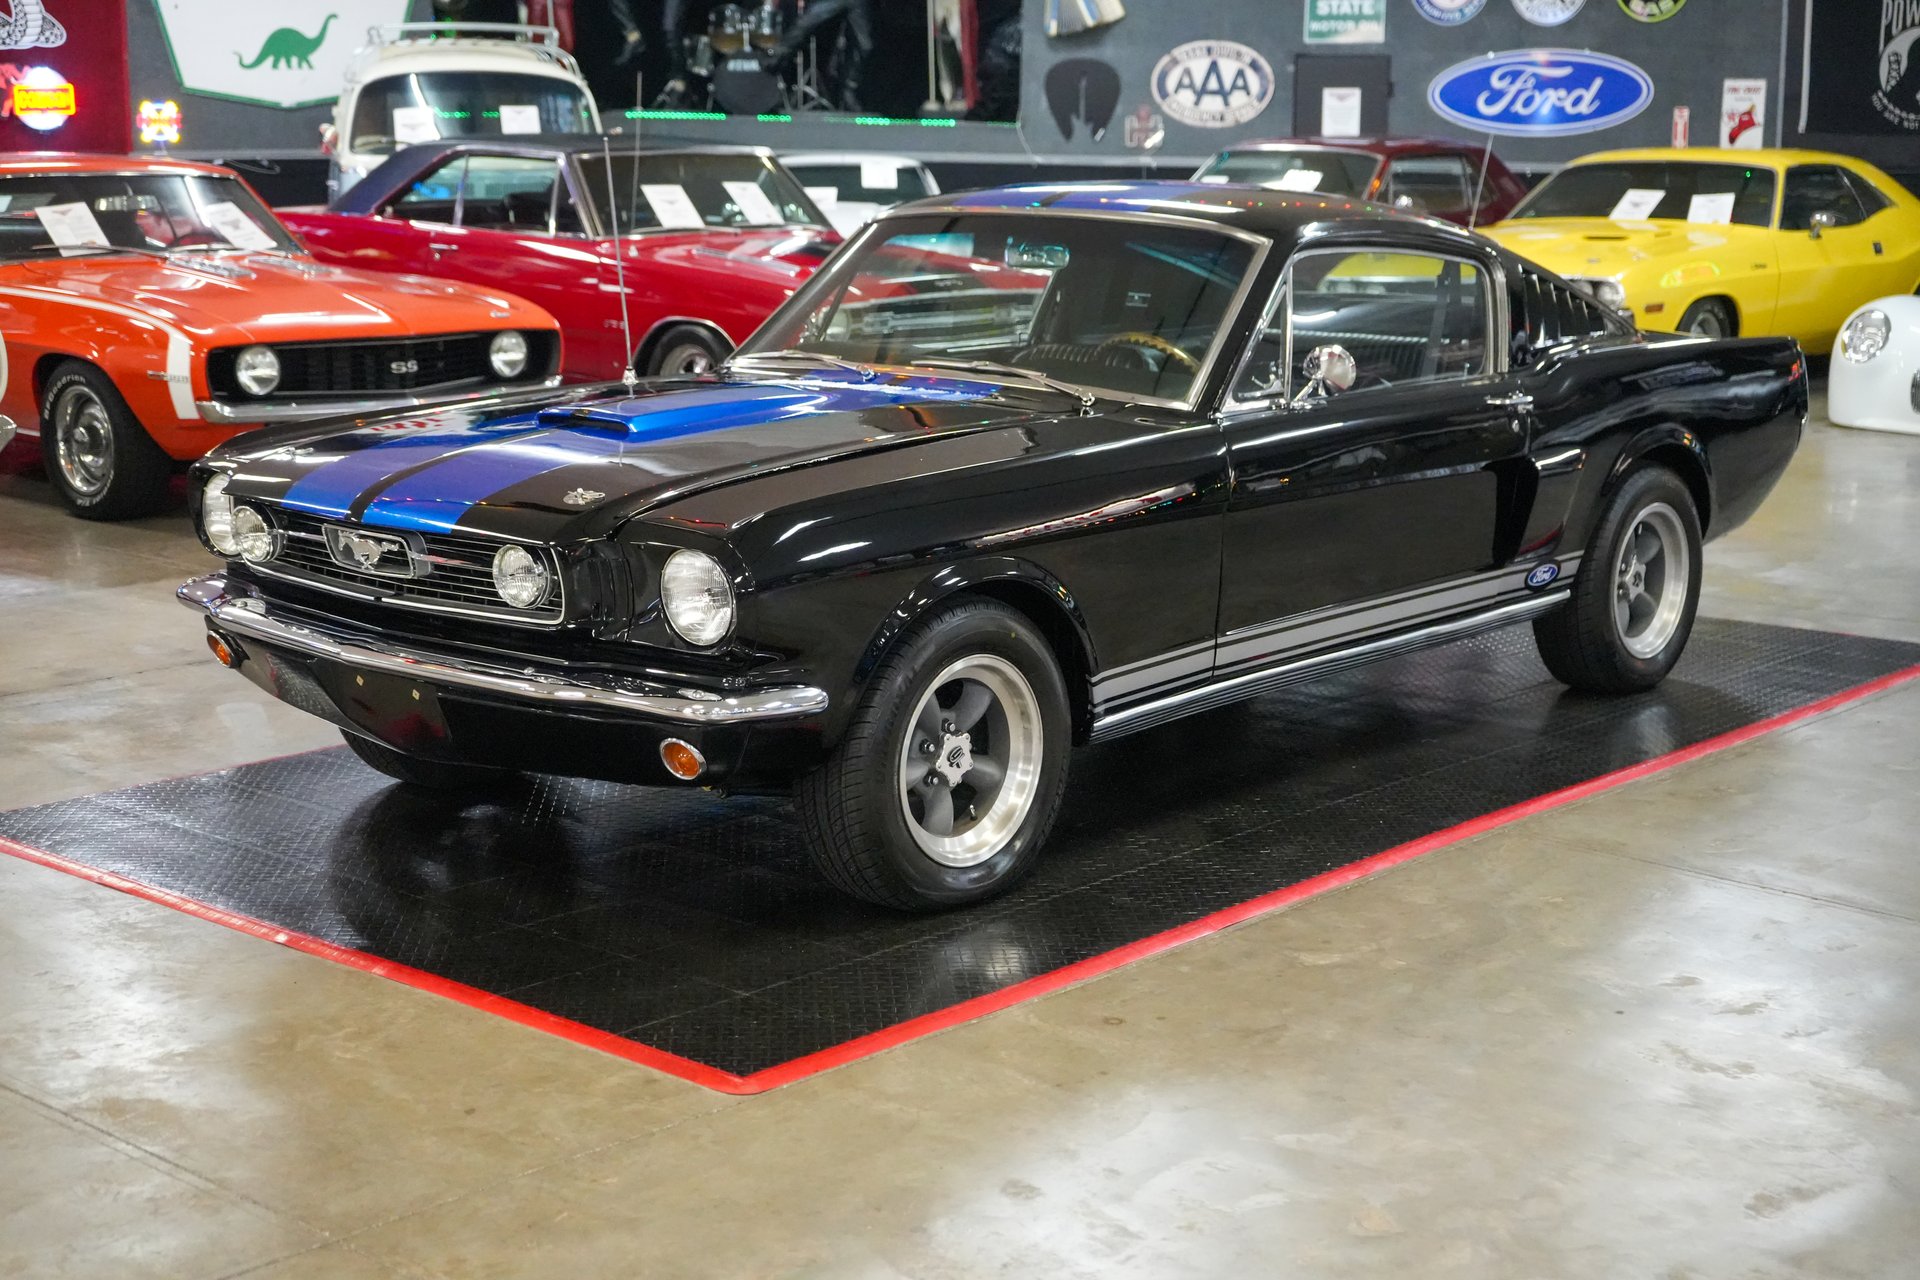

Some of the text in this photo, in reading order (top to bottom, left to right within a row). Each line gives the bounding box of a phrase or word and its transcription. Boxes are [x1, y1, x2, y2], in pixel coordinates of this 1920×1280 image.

[1316, 0, 1376, 16] STATE
[1310, 20, 1354, 33] MOTOR
[1174, 59, 1251, 107] AAA
[1475, 64, 1604, 116] Ford
[390, 359, 418, 374] SS
